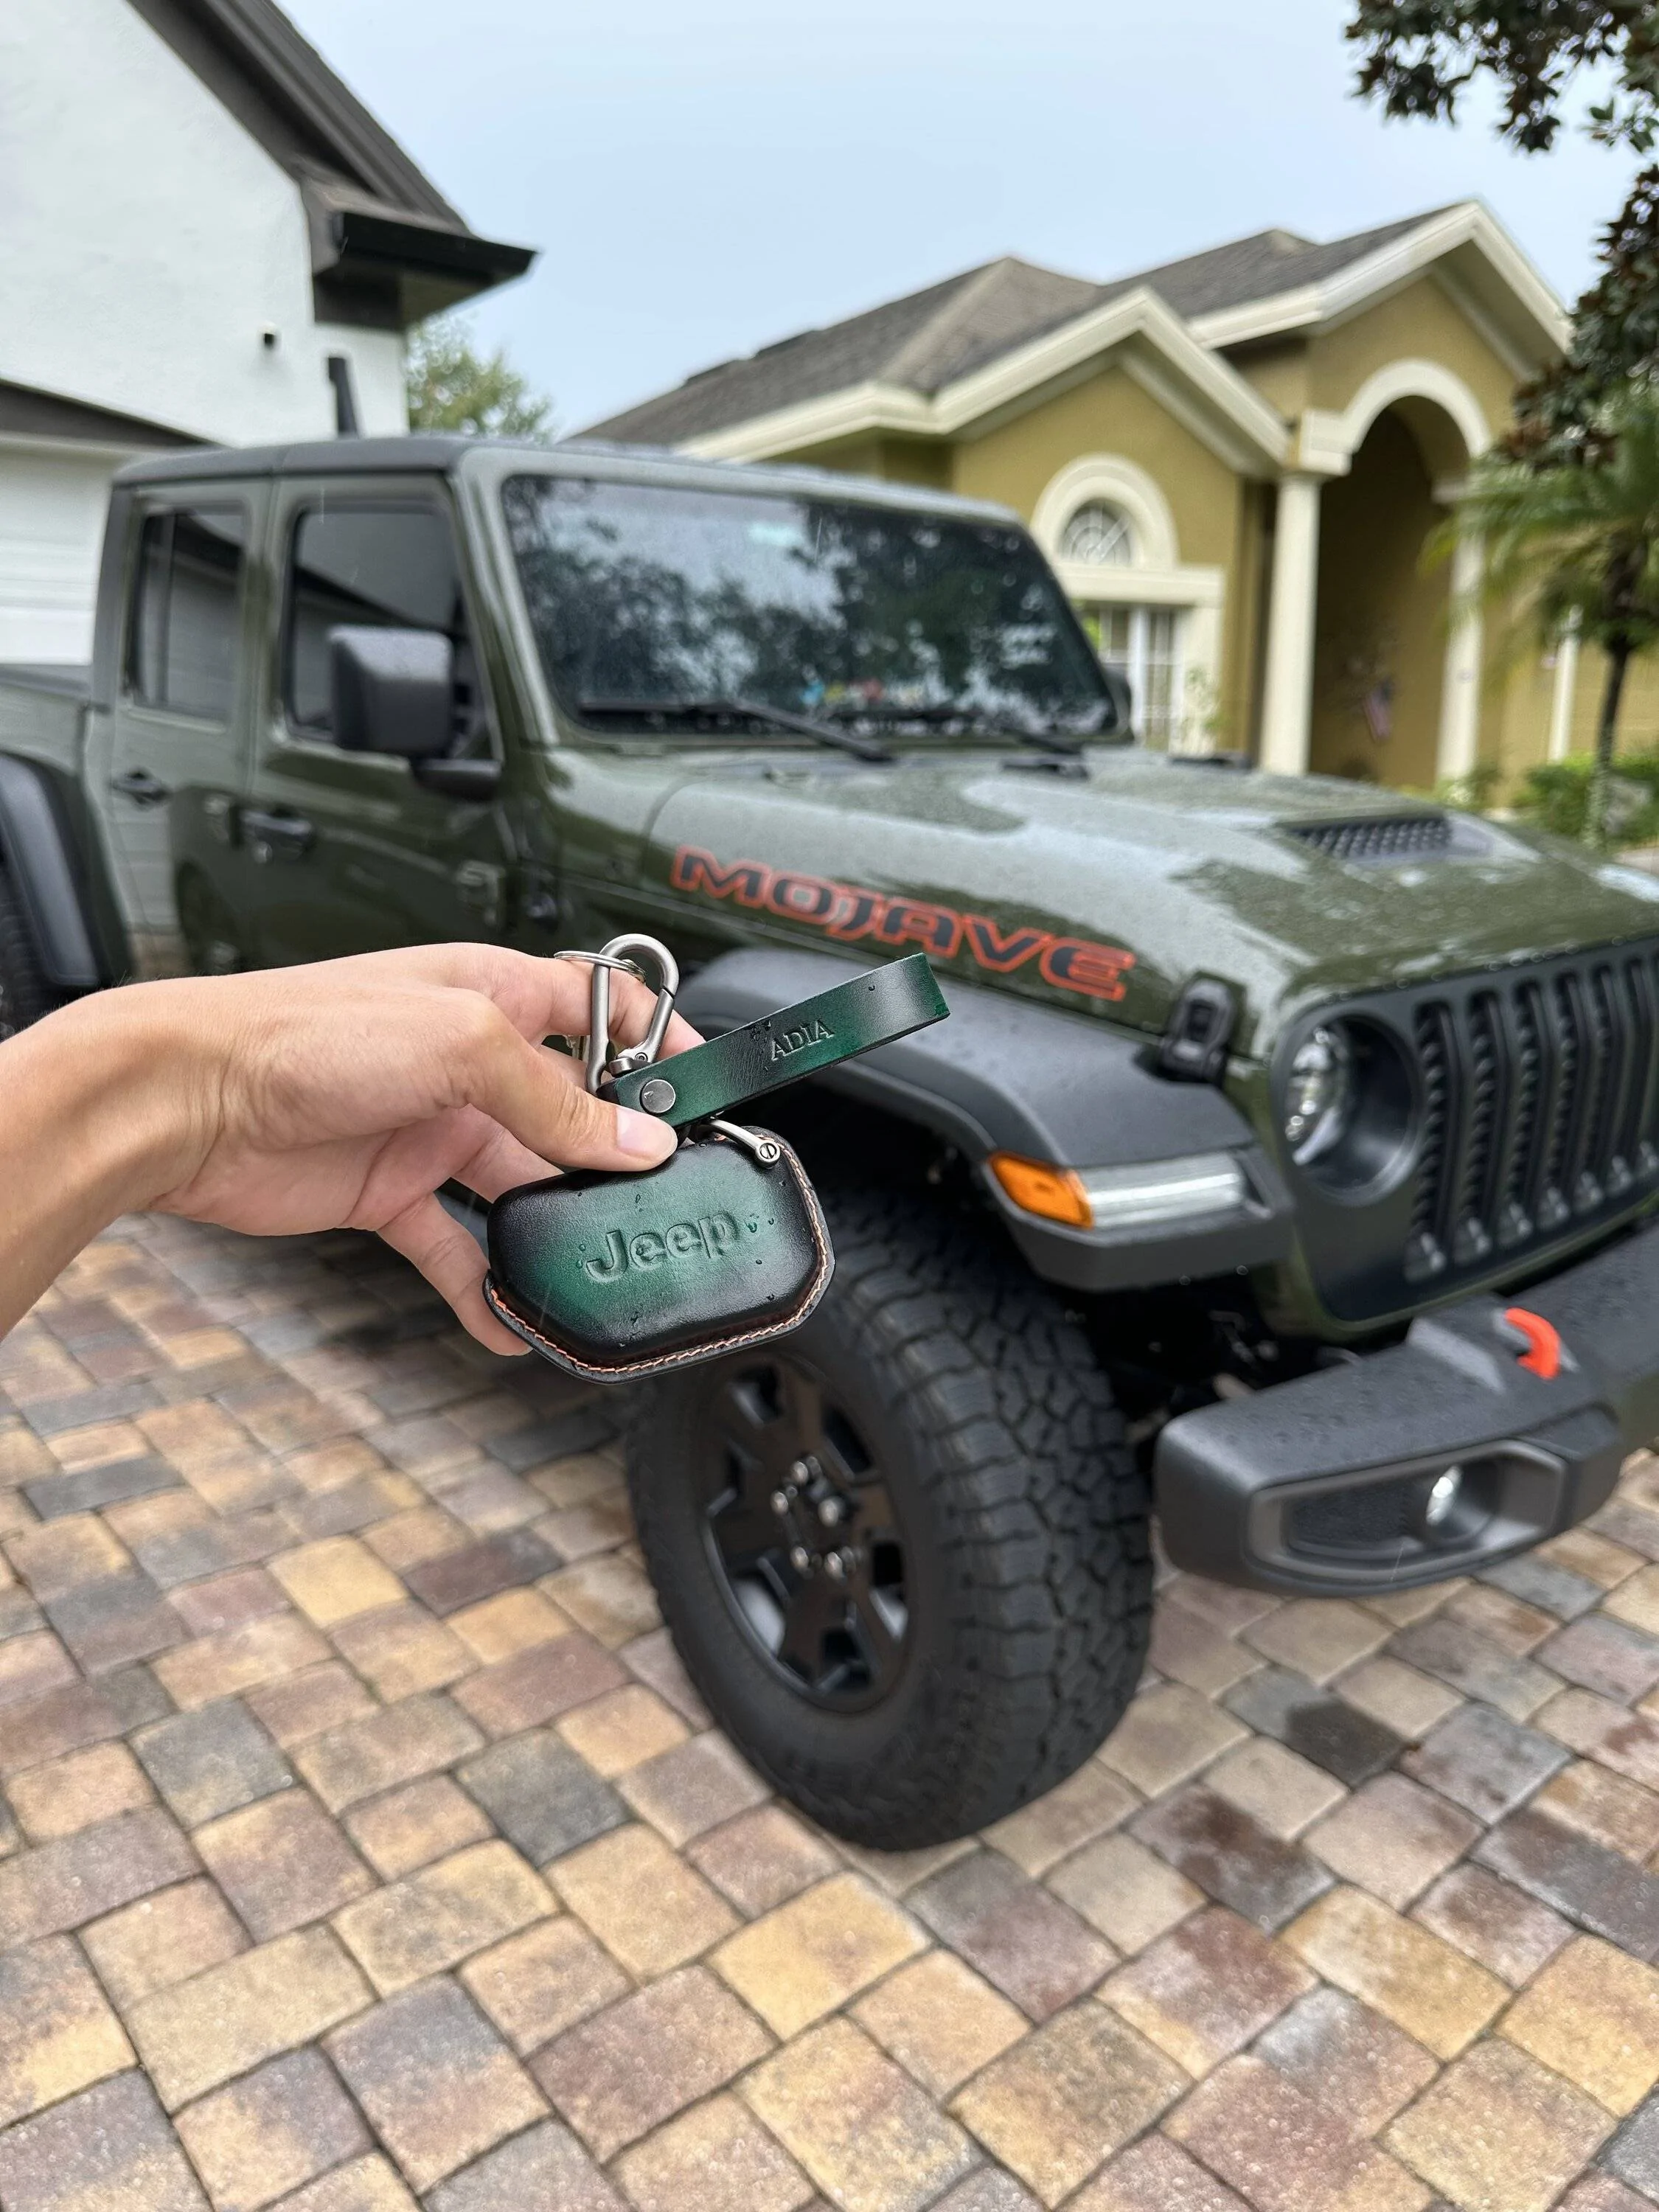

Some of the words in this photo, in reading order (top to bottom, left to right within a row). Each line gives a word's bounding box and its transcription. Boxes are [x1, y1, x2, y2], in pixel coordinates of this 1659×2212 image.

[672, 846, 1135, 1001] MOJAVE
[770, 1018, 835, 1061] ADIA
[585, 1209, 740, 1282] Jeep
